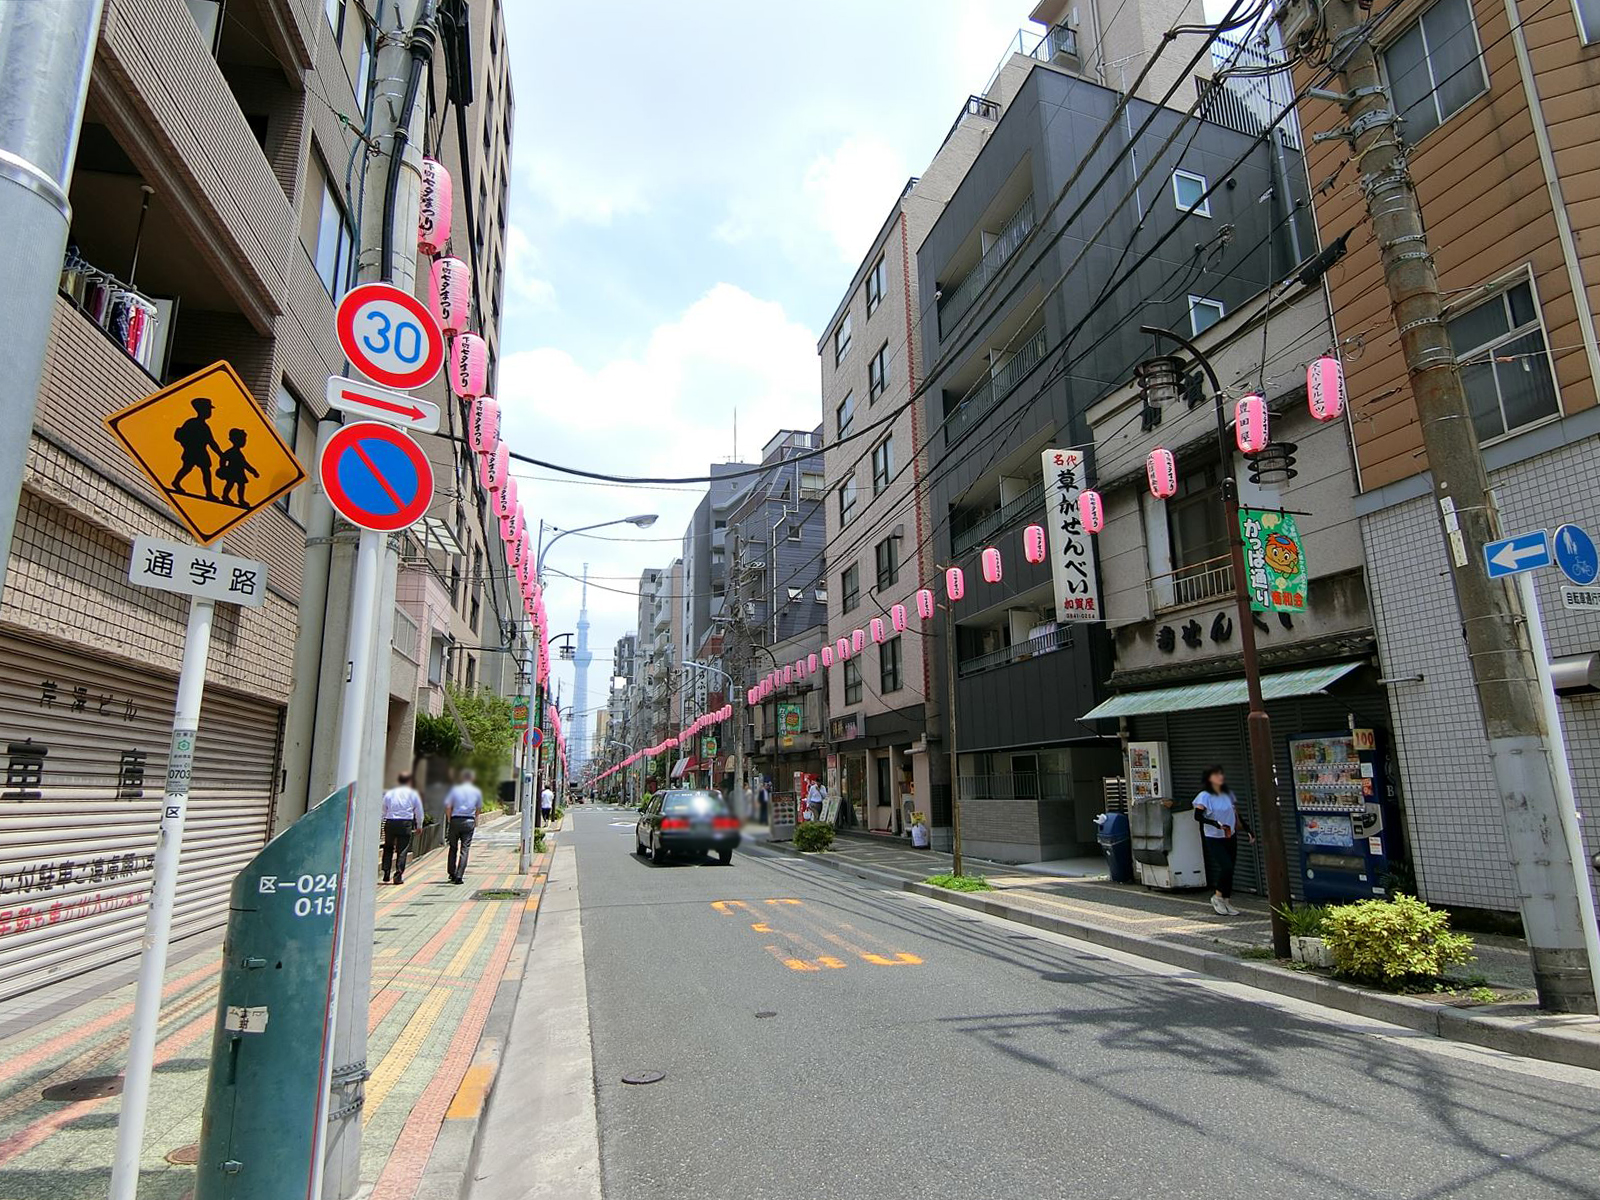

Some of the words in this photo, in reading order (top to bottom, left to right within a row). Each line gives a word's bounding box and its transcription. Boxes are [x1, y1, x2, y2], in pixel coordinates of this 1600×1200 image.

[363, 311, 422, 364] 30
[1053, 454, 1077, 466] 名代
[1056, 469, 1089, 595] 草加せんべい
[143, 547, 257, 596] 通学路
[1243, 518, 1270, 608] かっぱ通り
[1566, 592, 1600, 606] 自転車通行
[1355, 732, 1374, 747] 100
[1, 737, 148, 803] 車庫
[169, 769, 191, 779] 0703
[1318, 825, 1349, 836] PEPSI
